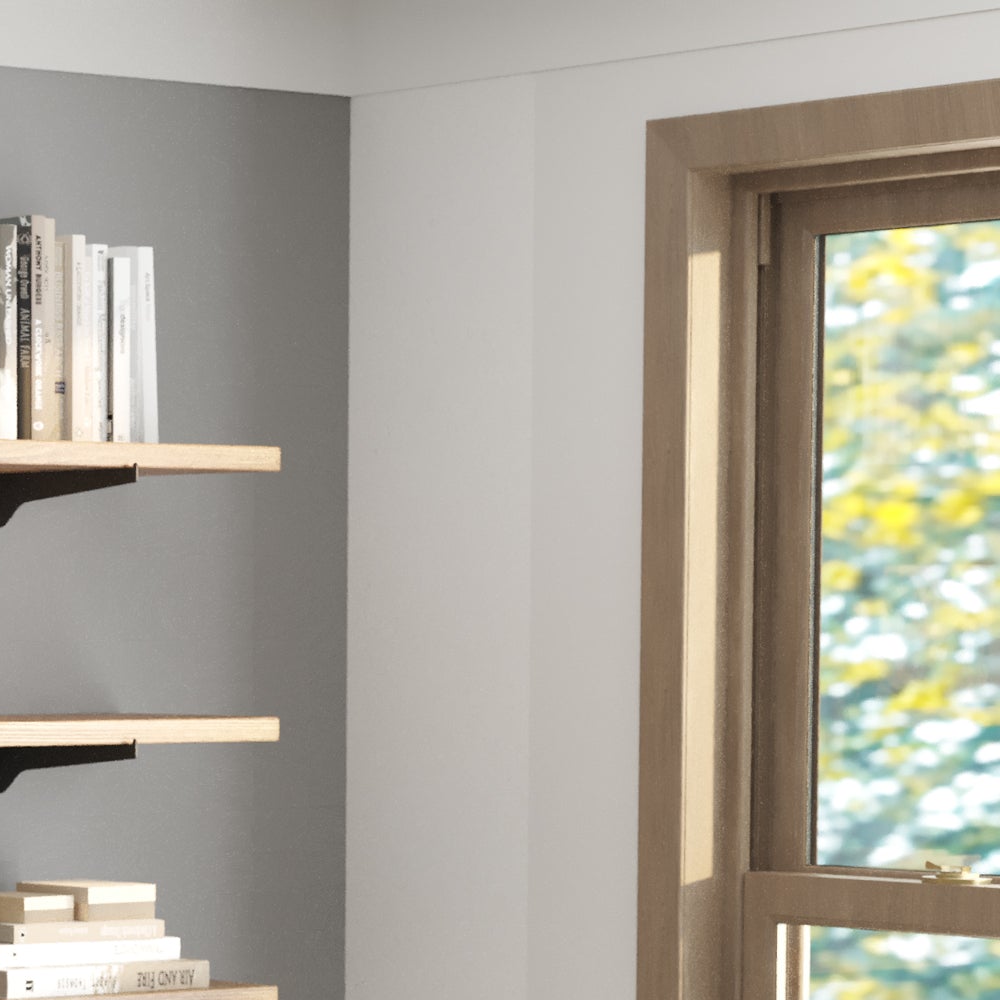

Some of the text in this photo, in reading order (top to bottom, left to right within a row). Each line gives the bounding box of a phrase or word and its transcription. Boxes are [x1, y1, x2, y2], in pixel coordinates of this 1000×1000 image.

[20, 307, 30, 368] ANIMAL FARM
[137, 969, 196, 989] AIR AND FIRE
